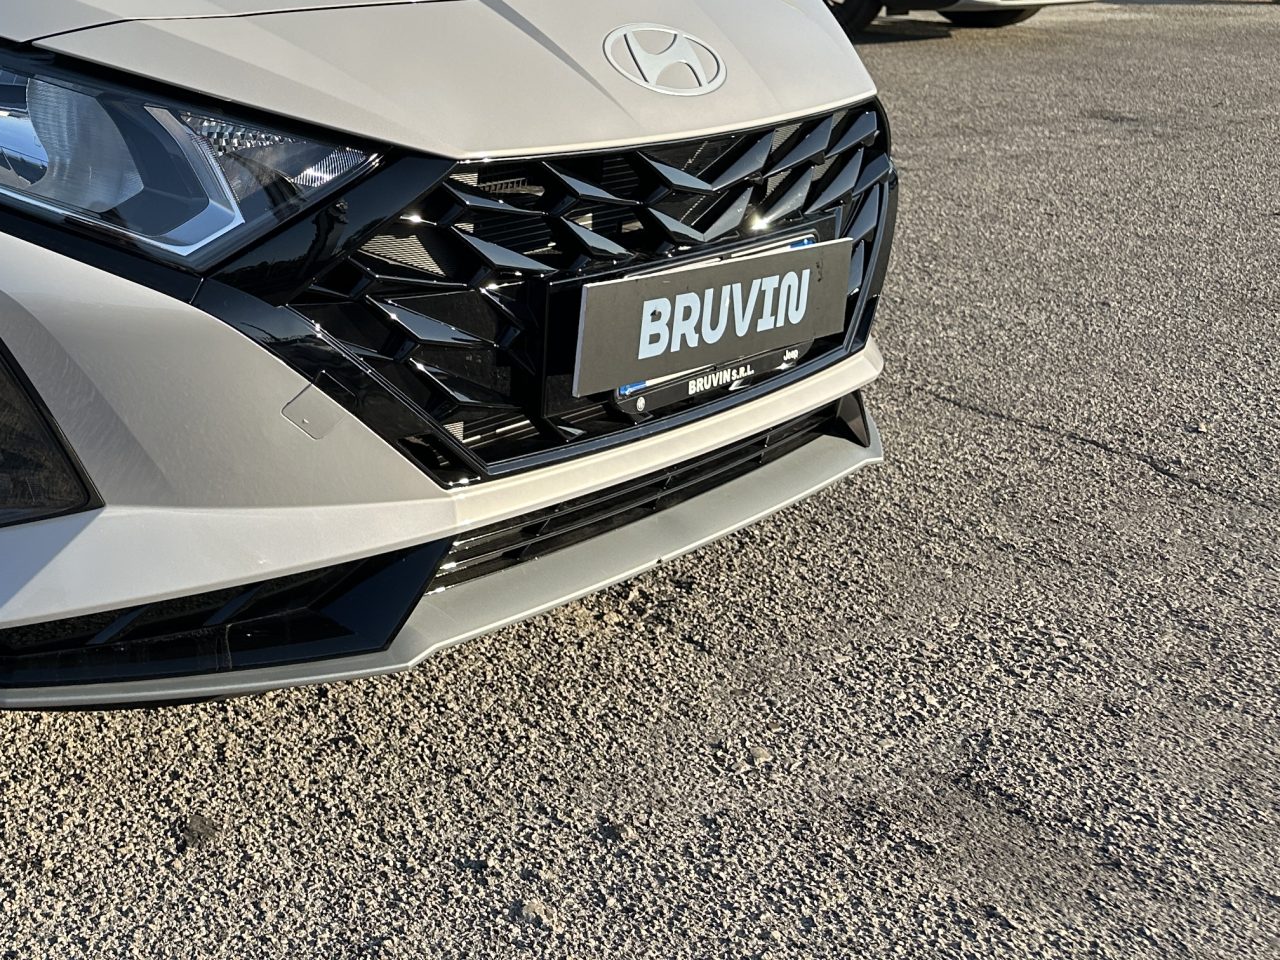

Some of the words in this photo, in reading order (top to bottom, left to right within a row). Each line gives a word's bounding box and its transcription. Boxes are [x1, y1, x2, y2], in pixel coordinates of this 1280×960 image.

[638, 268, 811, 360] BRUVIN
[784, 349, 799, 361] Jeep
[688, 368, 731, 395] BRUVIN
